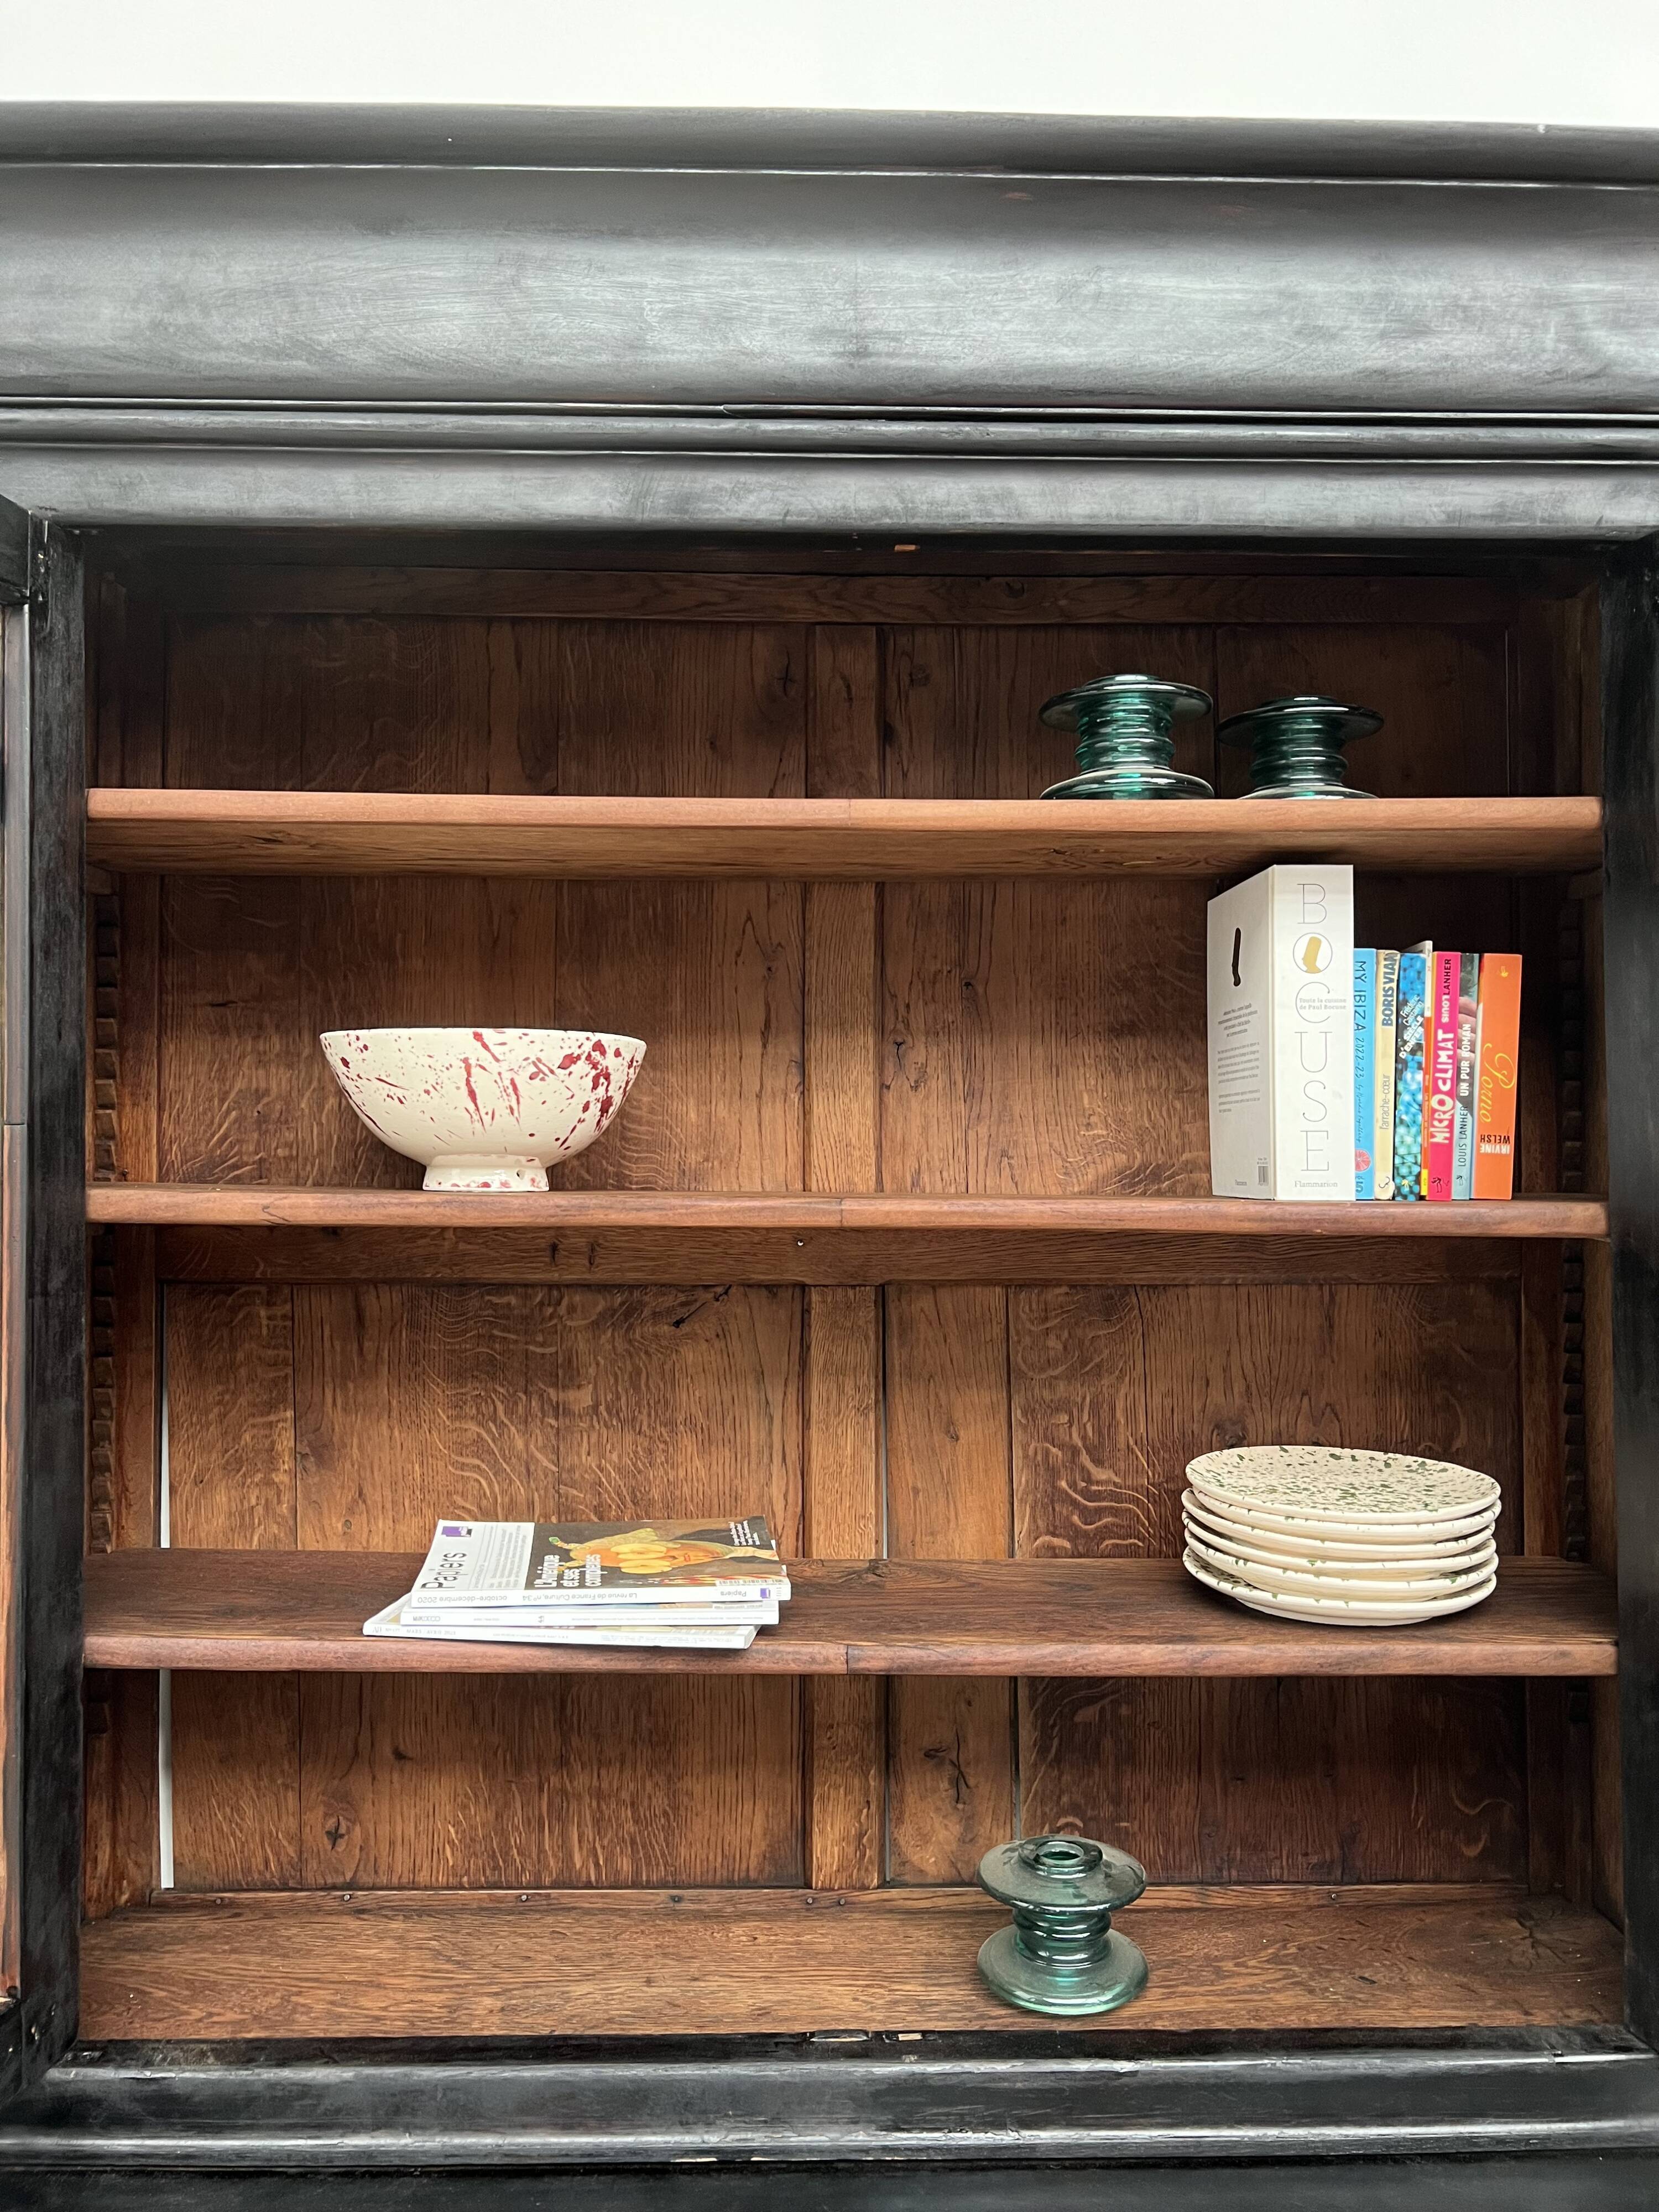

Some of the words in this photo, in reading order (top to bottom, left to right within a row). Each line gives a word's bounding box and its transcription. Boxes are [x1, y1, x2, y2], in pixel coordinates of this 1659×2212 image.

[1383, 951, 1399, 985] VIAN
[1443, 958, 1452, 995] LANHER
[1354, 990, 1366, 1031] IBIZA
[1381, 986, 1395, 1027] BORIS
[1441, 995, 1451, 1023] LOUIS
[1292, 883, 1333, 1171] BOCUSE
[1461, 1024, 1472, 1057] ROMAN
[1355, 1037, 1365, 1079] 2022-23
[1460, 1060, 1470, 1080] PUR
[1459, 1083, 1469, 1097] UN
[1479, 1043, 1515, 1123] Porno
[1459, 1106, 1468, 1140] LANHER
[1480, 1134, 1511, 1144] WELSH
[1458, 1142, 1467, 1167] LOUIS
[1480, 1144, 1510, 1155] IRVINE
[420, 1552, 468, 1589] Papiers
[563, 1568, 580, 1580] ses
[439, 1595, 508, 1603] octobre-décembre
